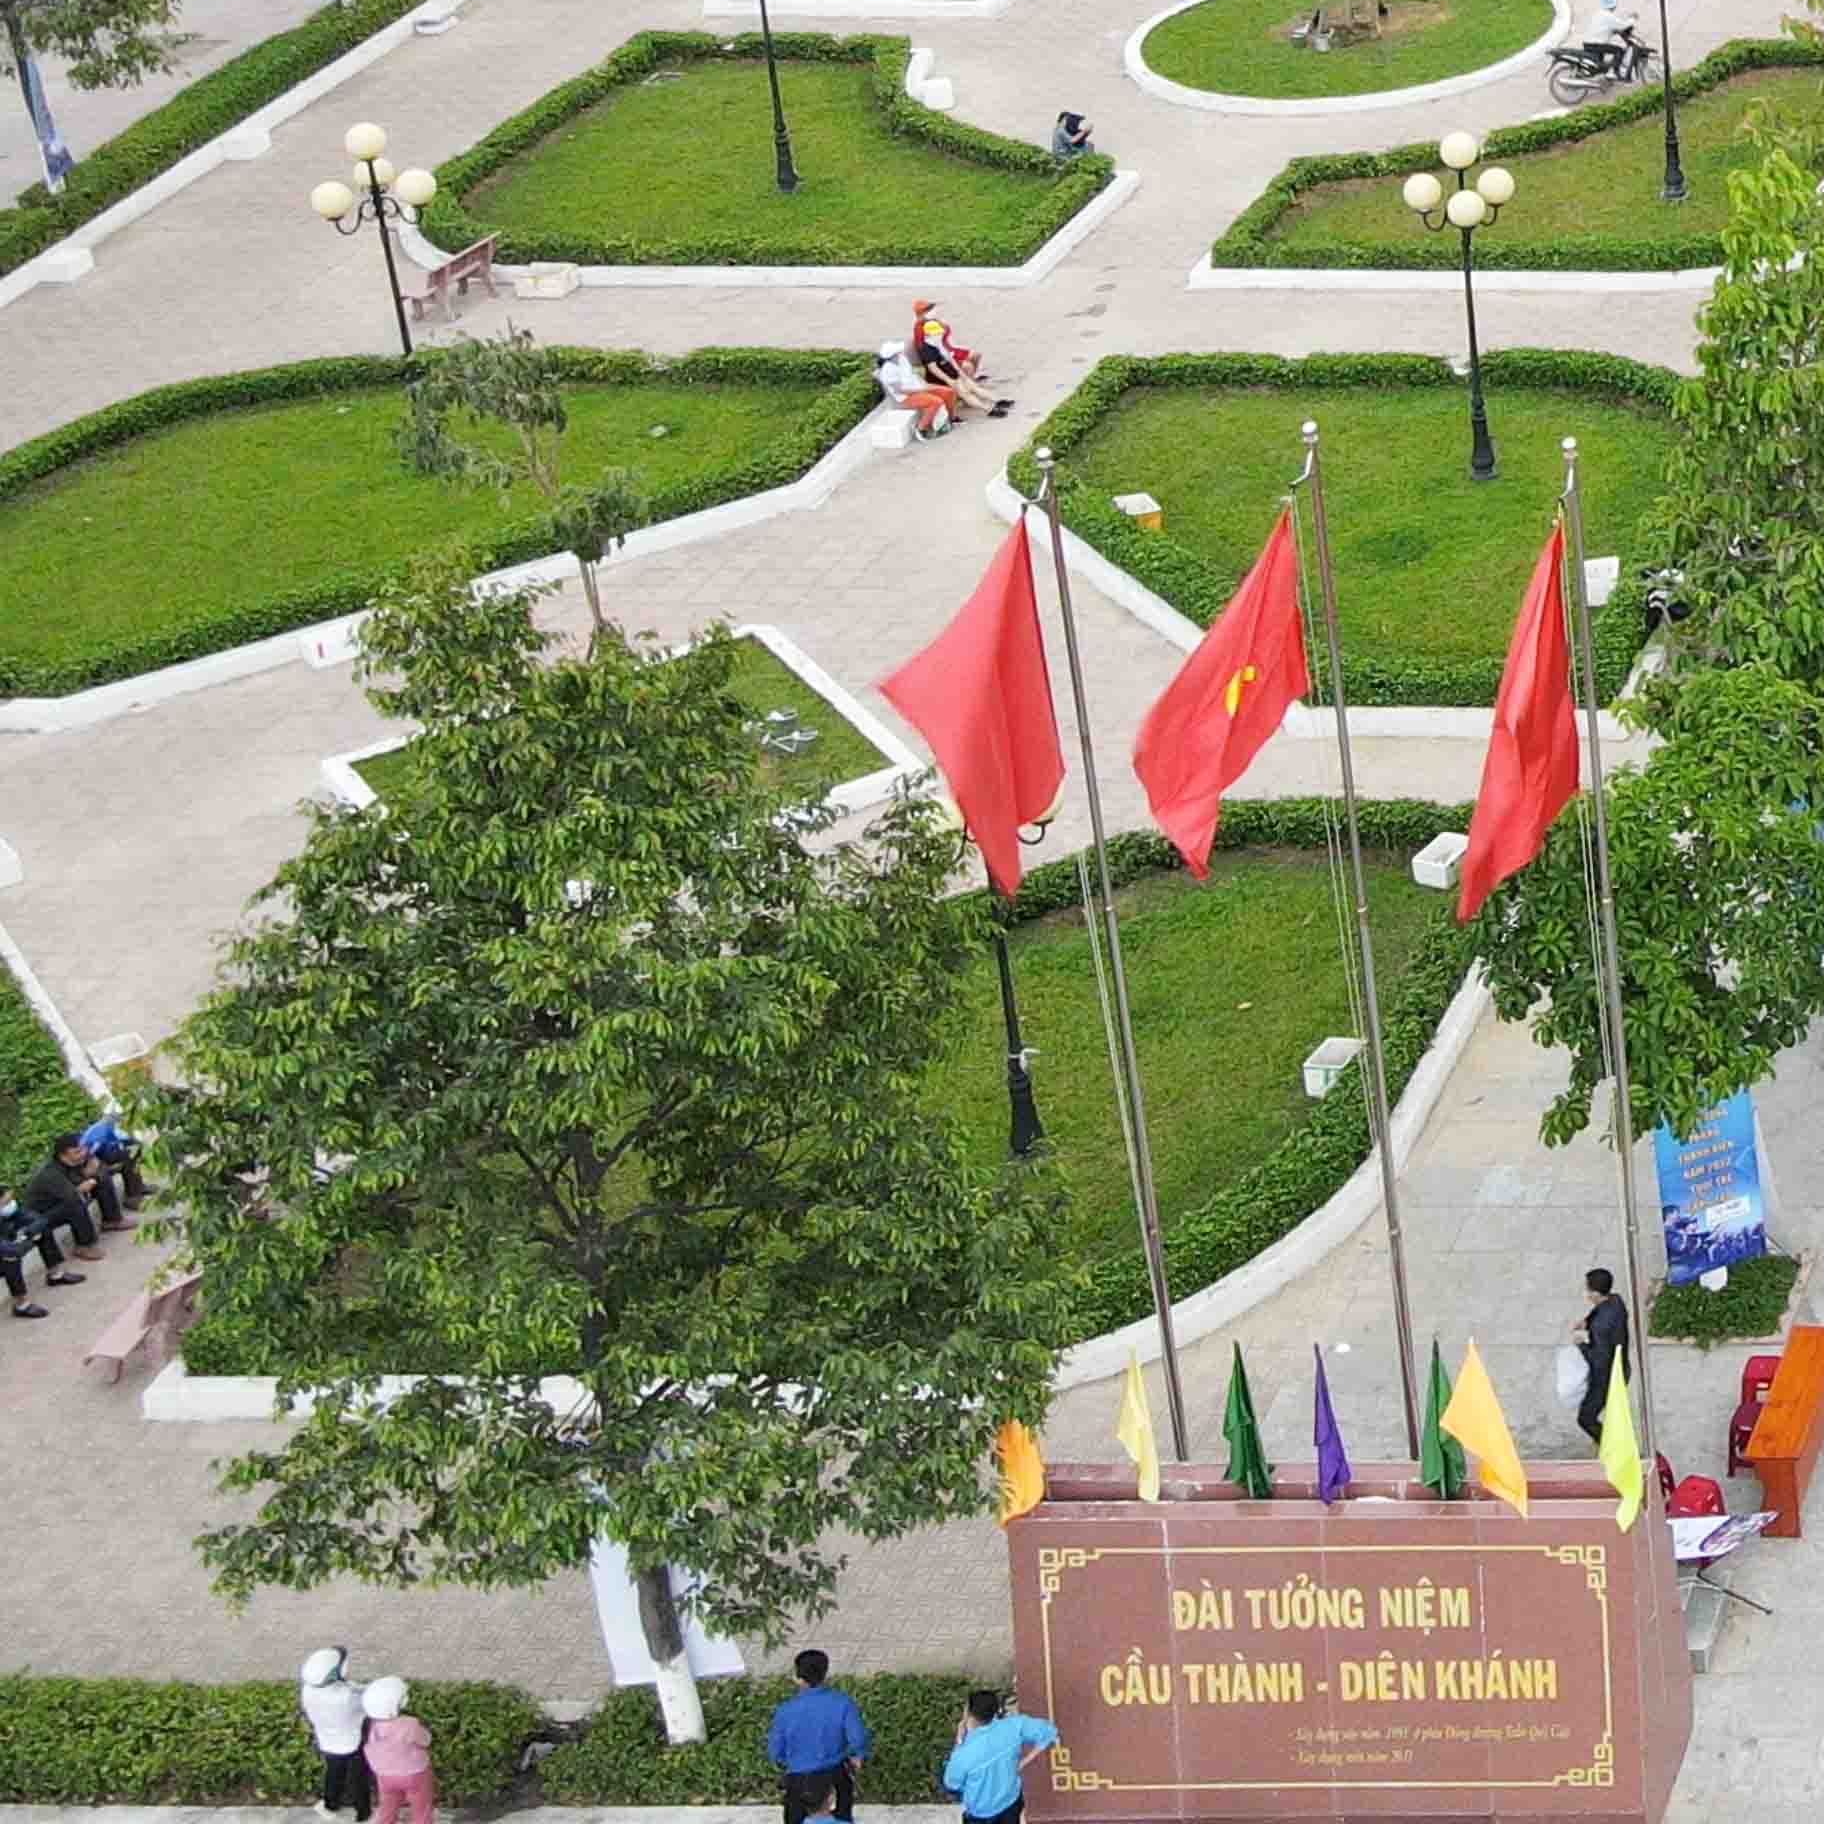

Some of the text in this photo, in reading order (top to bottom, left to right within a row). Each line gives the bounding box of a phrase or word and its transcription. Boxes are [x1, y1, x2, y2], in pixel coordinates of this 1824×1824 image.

[1172, 1573, 1472, 1636] ĐÀI TƯỞNG NIỆM
[1100, 1645, 1558, 1706] CẦU THÀNH - DIÊN KHÁNH
